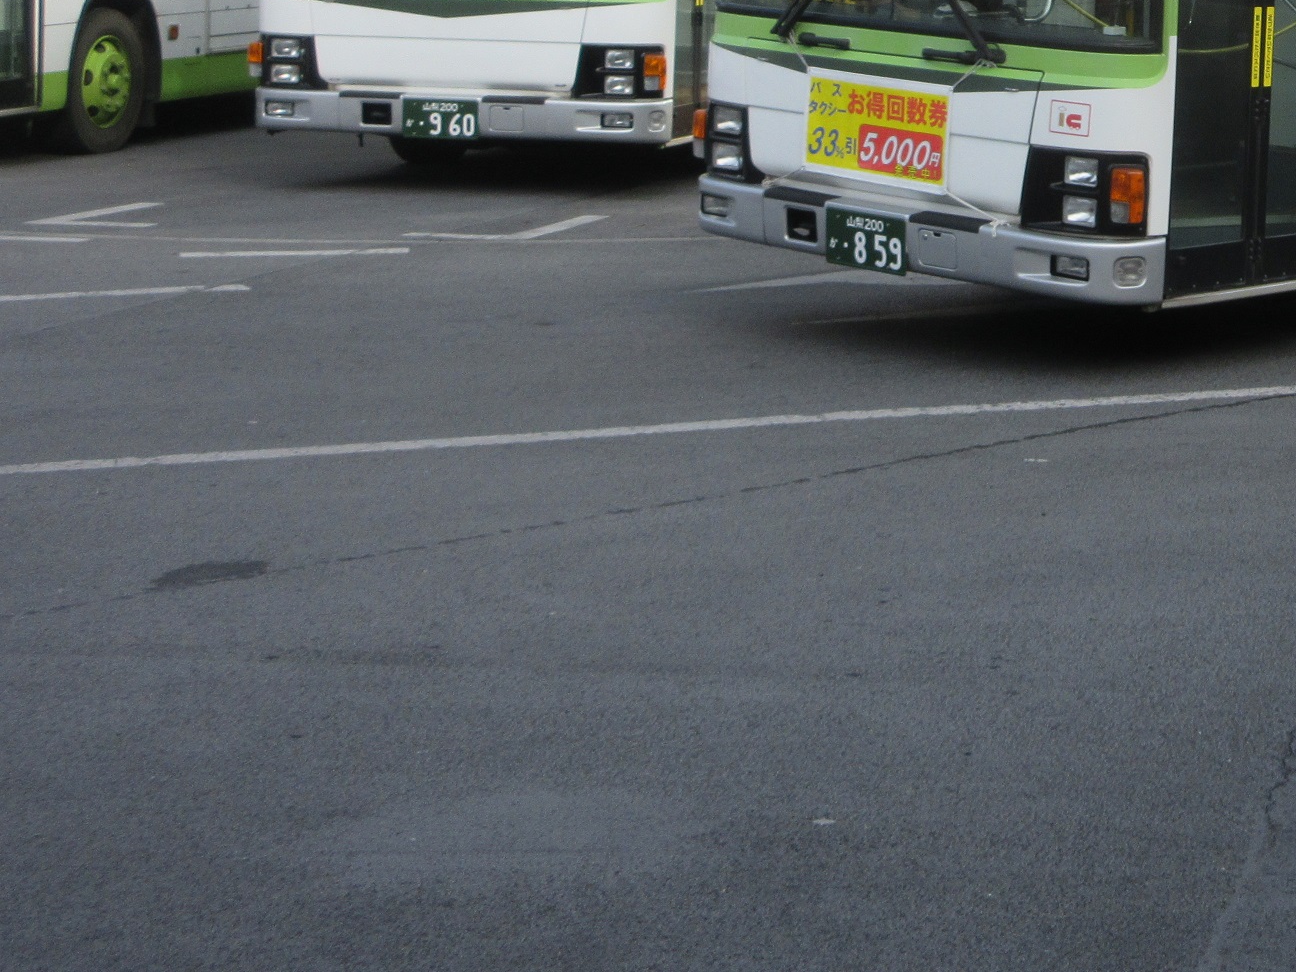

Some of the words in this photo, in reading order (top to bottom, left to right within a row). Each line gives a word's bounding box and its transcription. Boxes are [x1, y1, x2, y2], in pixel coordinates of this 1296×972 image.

[810, 81, 842, 97] バス
[808, 99, 847, 117] タクシー
[847, 88, 949, 128] お得回数券
